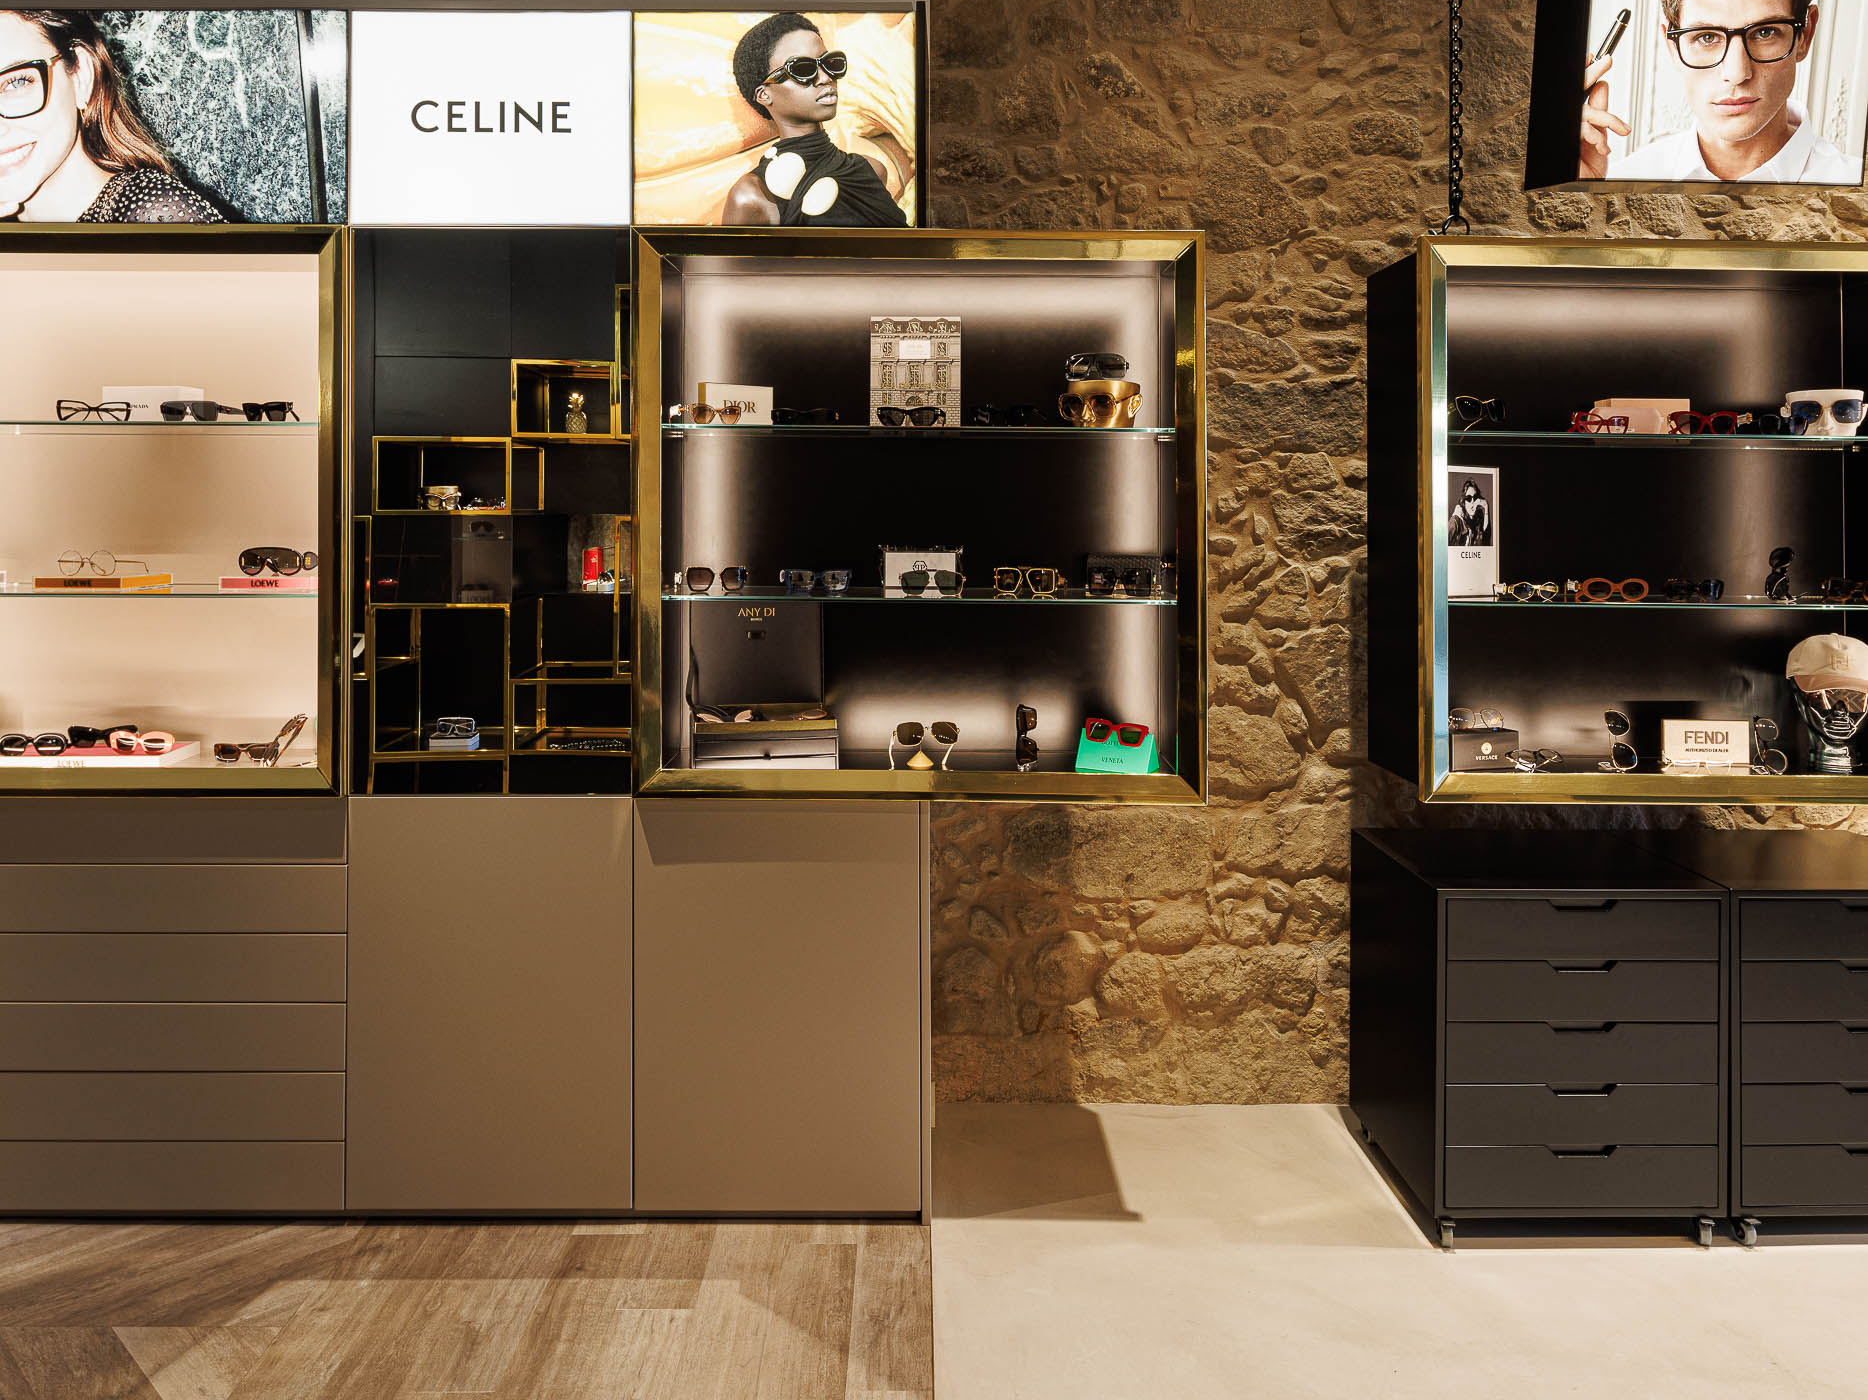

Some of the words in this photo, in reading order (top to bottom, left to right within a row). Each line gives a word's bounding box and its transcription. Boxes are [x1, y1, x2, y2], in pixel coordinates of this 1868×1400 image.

[411, 100, 572, 133] CELINE
[1460, 551, 1482, 559] CELINE
[250, 579, 279, 588] LOEWE
[737, 607, 761, 617] ANY
[763, 607, 776, 617] DI
[1684, 731, 1729, 745] FENDI
[57, 759, 87, 768] LOEWE
[1101, 756, 1124, 765] VENETA
